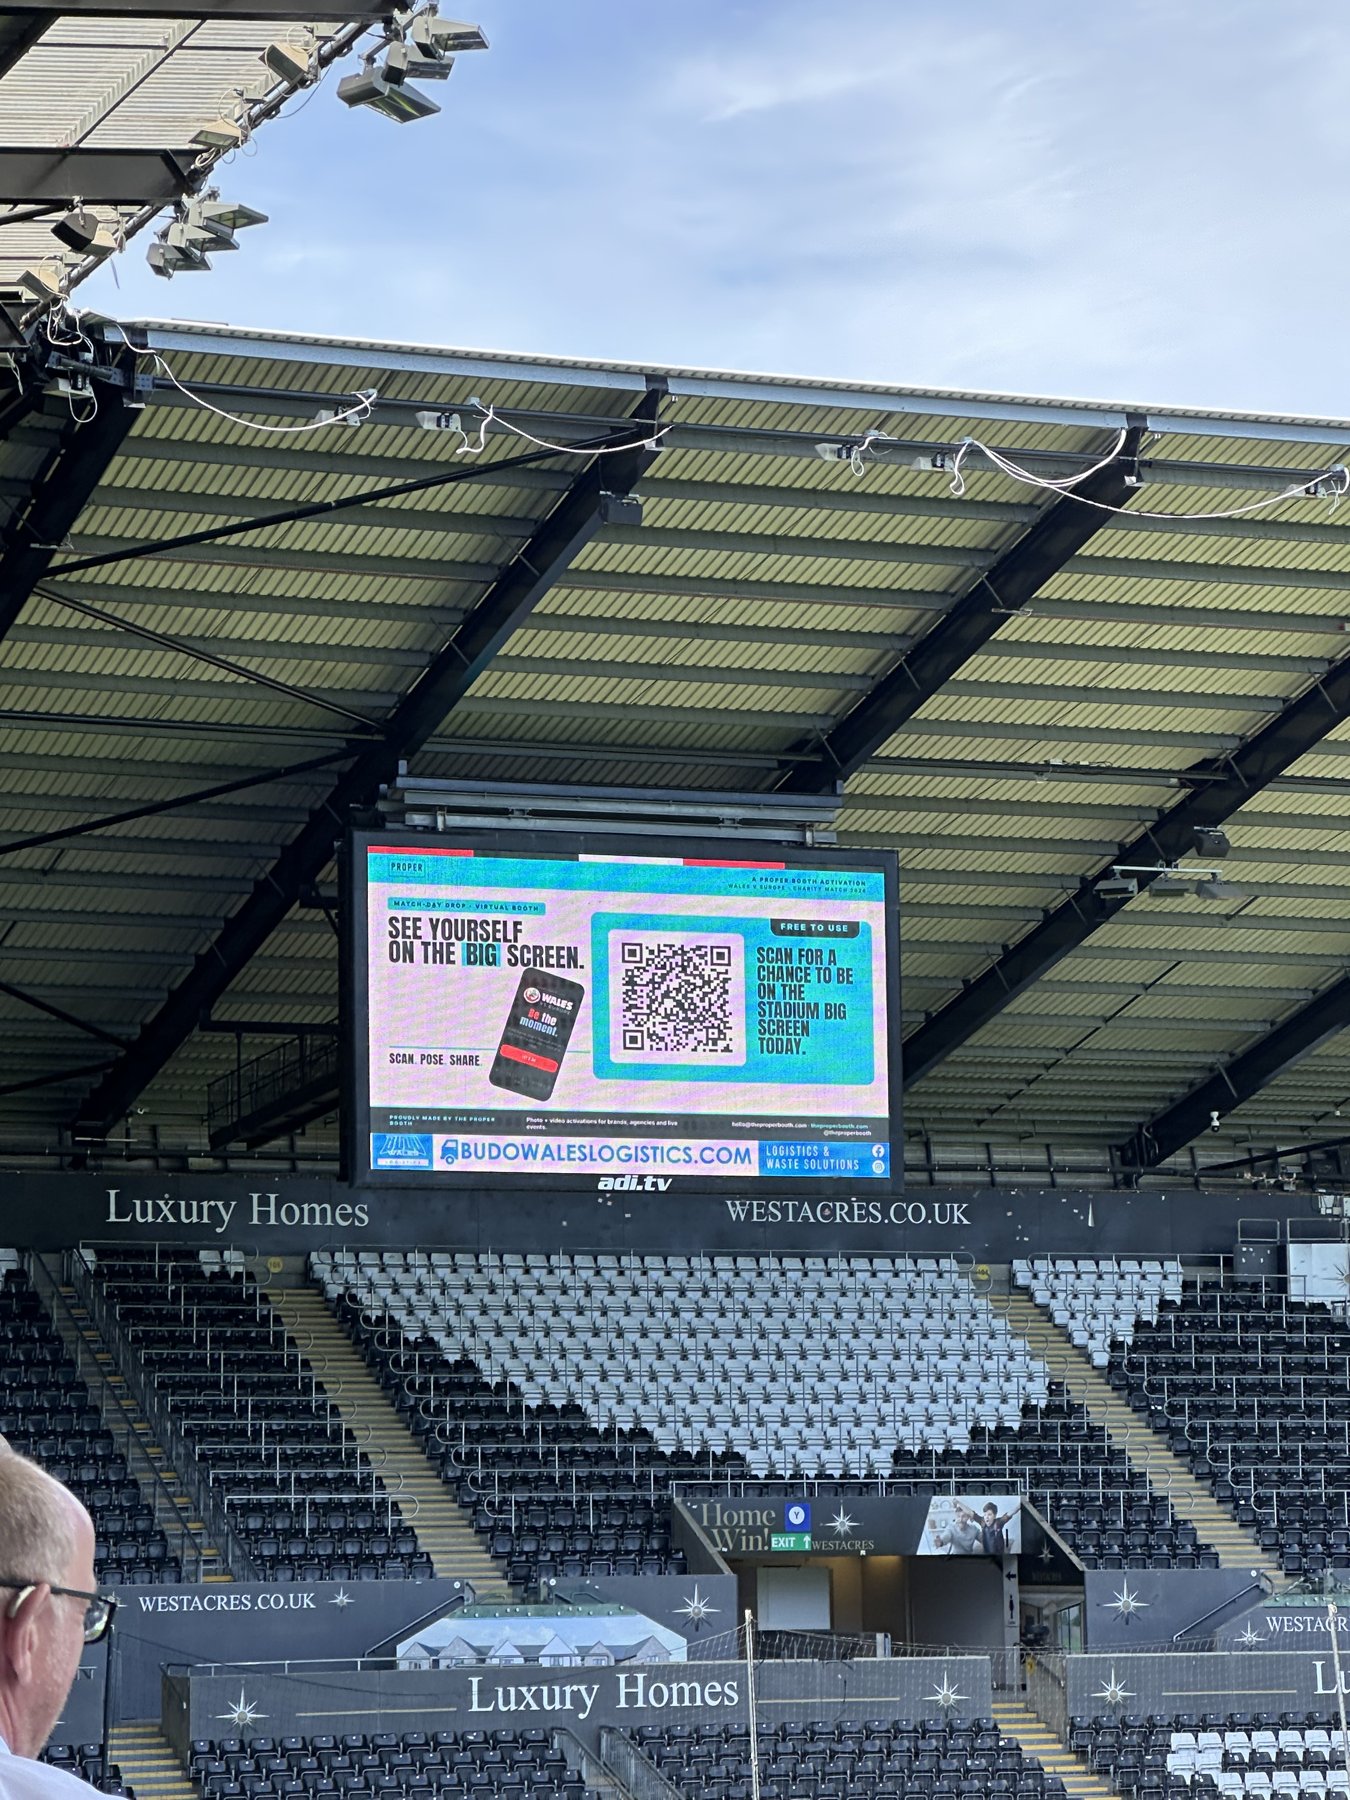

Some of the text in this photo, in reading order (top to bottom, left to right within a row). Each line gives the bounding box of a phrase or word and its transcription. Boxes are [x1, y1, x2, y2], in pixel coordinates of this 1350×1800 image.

[391, 862, 423, 872] PROPER
[475, 903, 509, 911] VIRTUAL
[388, 916, 523, 943] SEE YOURSELF
[780, 923, 849, 932] FREE TO USE
[388, 940, 585, 969] ON THE BIG SCREEN.
[757, 947, 837, 966] SCAN FOR A
[757, 965, 854, 985] CHANCE TO BE
[541, 992, 574, 1011] WALES
[757, 983, 805, 1001] ON THE
[541, 1012, 557, 1026] the
[757, 1001, 847, 1020] STADIUM BIG
[519, 1016, 559, 1038] moment.
[758, 1019, 810, 1037] SCREEN
[758, 1037, 806, 1055] TODAY.
[461, 1143, 752, 1165] BUDOWALESLOGISTICS.COM
[766, 1146, 830, 1157] LOGISTICS &
[766, 1159, 860, 1170] WASTE SOLUTIONS
[598, 1175, 673, 1192] adi.tv
[105, 1189, 369, 1233] Luxury Homes
[726, 1200, 972, 1225] WESTACRES.CO.UK
[702, 1503, 776, 1527] Home
[794, 1511, 800, 1520] Y
[711, 1528, 769, 1551] Win!
[771, 1537, 796, 1548] EXIT
[812, 1540, 875, 1551] WESTACRES
[139, 1593, 316, 1613] WESTACRES.CO.UK
[468, 1673, 739, 1720] Luxury Homes
